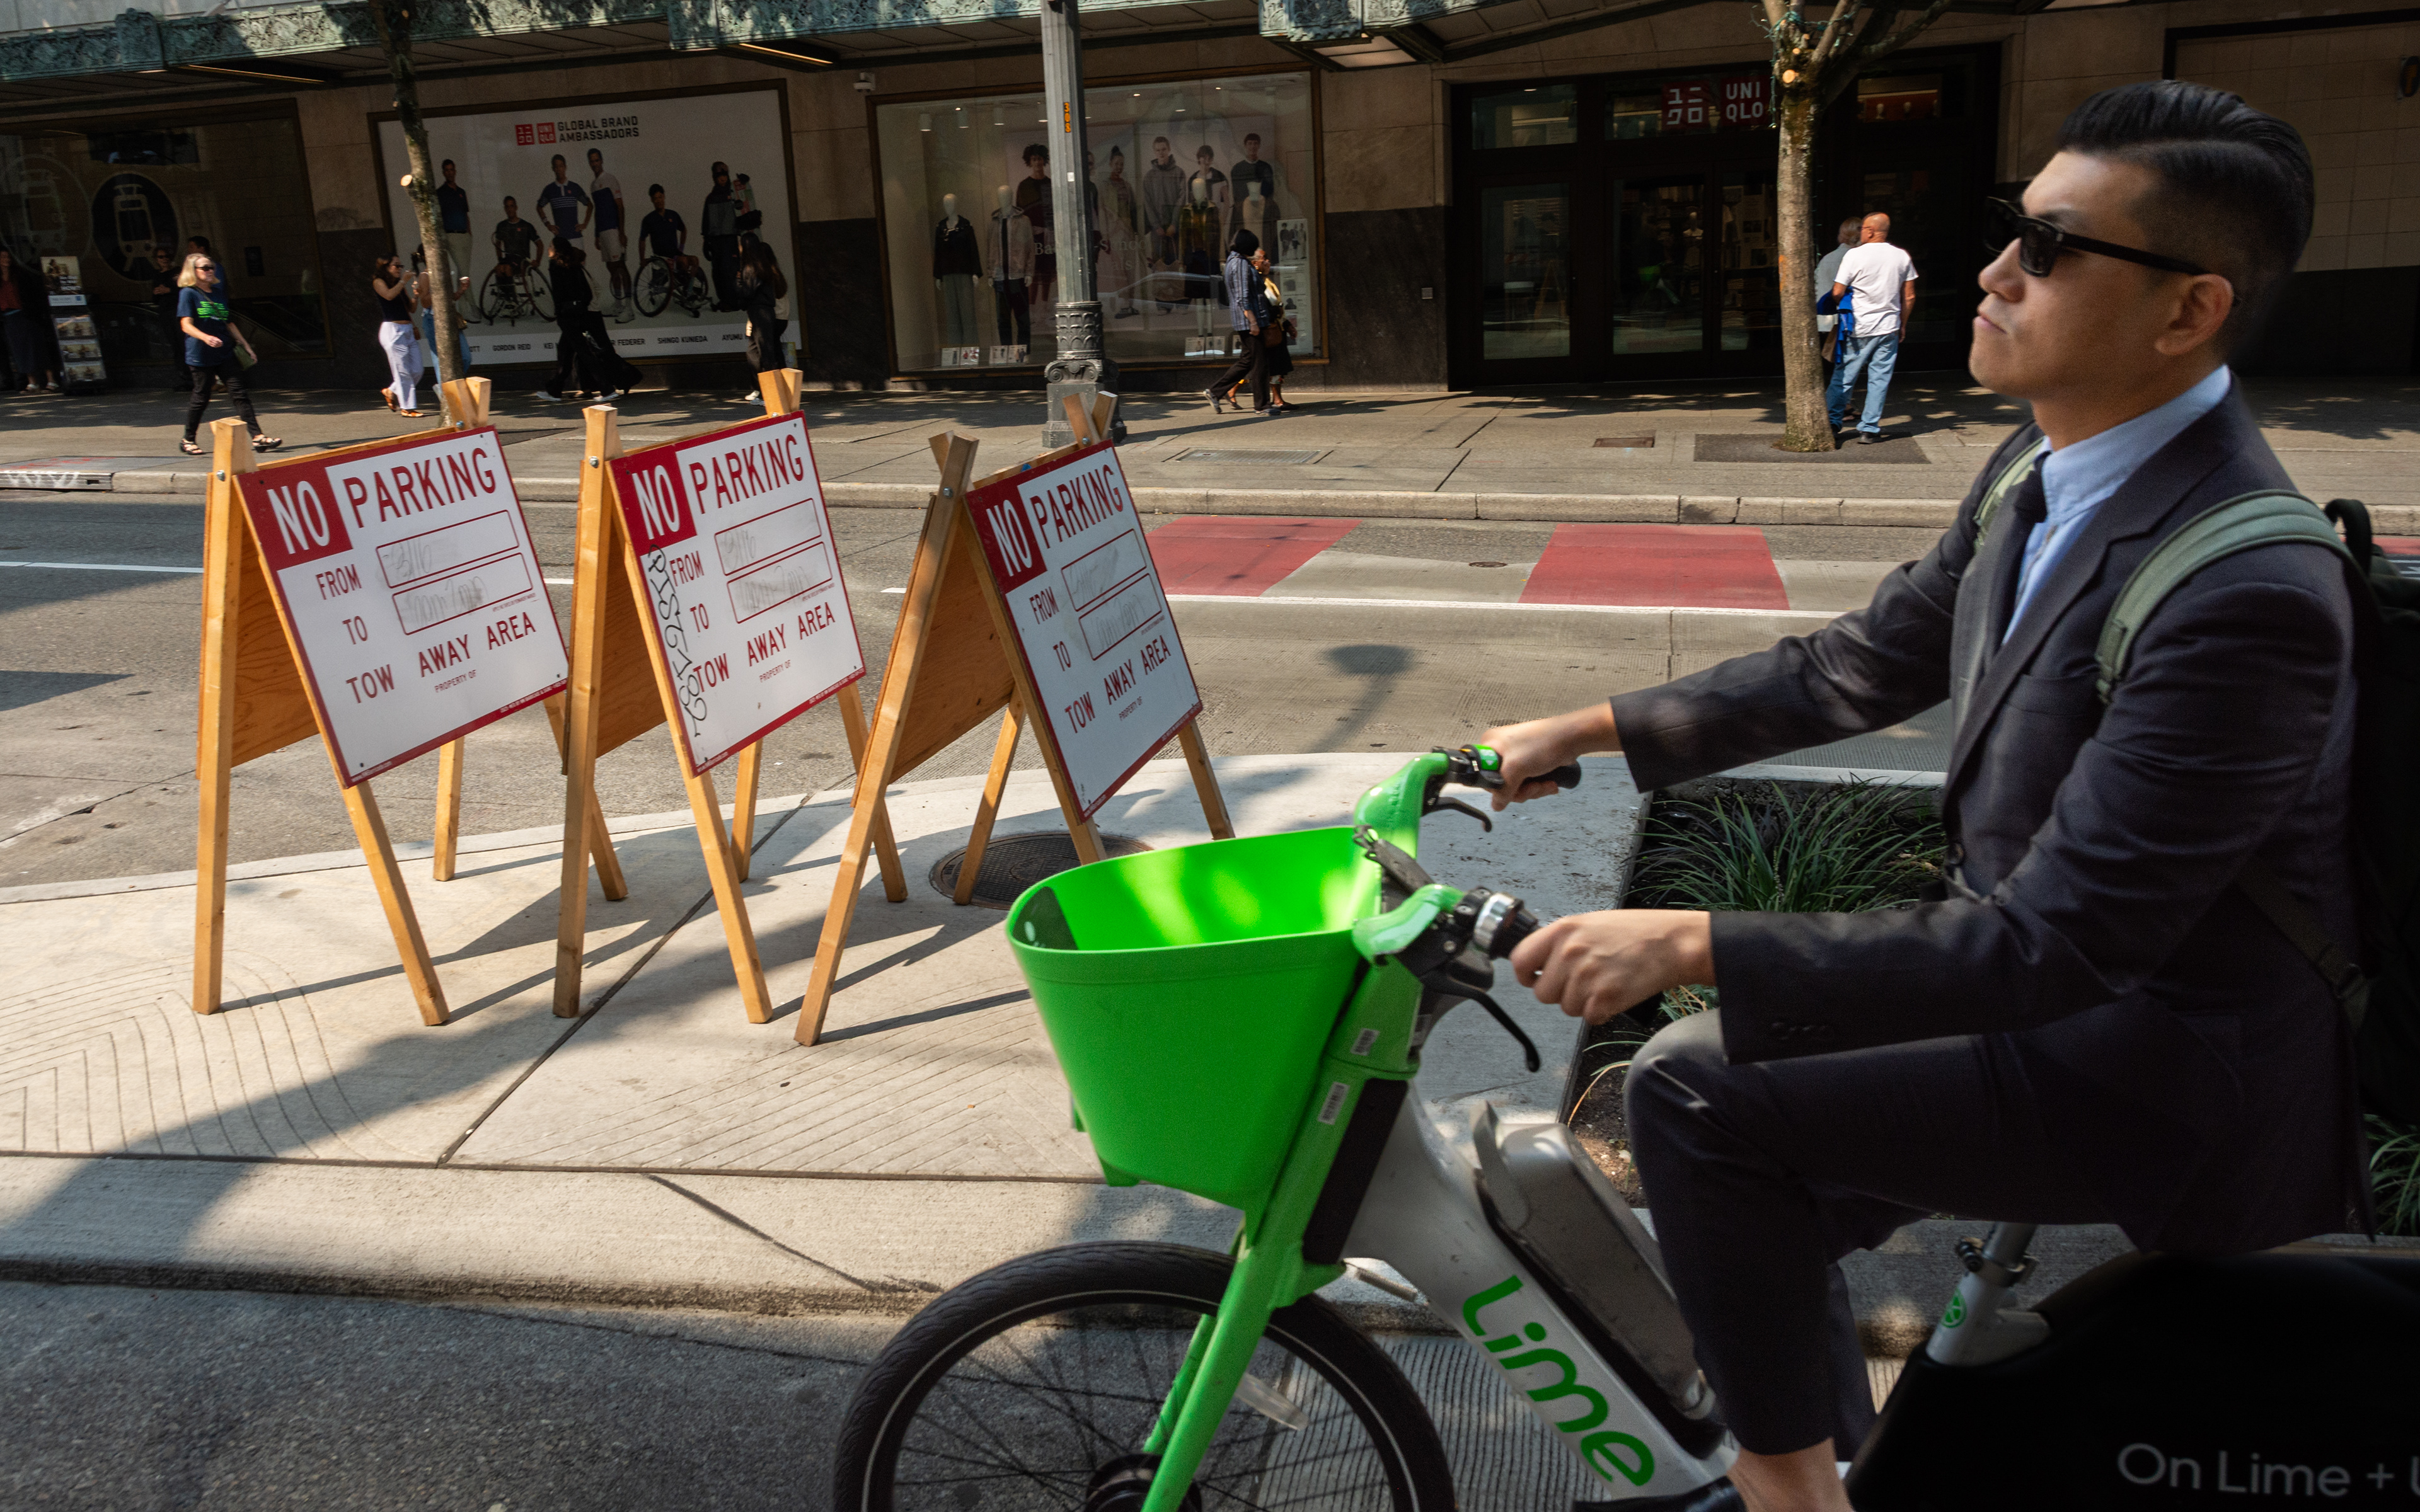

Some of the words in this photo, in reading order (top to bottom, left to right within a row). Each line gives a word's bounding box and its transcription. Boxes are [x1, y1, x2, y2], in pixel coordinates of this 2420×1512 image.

[1668, 87, 1703, 105] ユニ
[1726, 82, 1760, 100] UNI
[557, 119, 598, 131] GLOBAL
[601, 115, 638, 128] BRAND
[1667, 107, 1702, 125] クロ
[1726, 101, 1763, 122] QLO
[538, 124, 553, 133] UNI
[539, 134, 555, 144] QLO
[558, 127, 640, 143] AMBASSADORS
[267, 481, 330, 554] NO
[343, 448, 497, 529] PARKING
[632, 465, 681, 540] NO
[689, 434, 805, 515] PARKING
[986, 500, 1033, 577] NO
[1030, 464, 1124, 549] PARKING
[316, 564, 362, 600] FROM
[669, 551, 705, 587] FROM
[690, 603, 710, 633] TO
[1029, 587, 1059, 624] FROM
[343, 616, 368, 645] TO
[346, 665, 395, 704] TOW
[418, 634, 473, 678] AWAY
[487, 612, 536, 650] AREA
[693, 653, 730, 692] TOW
[747, 624, 787, 667] AWAY
[798, 602, 836, 639] AREA
[1053, 641, 1071, 672] TO
[434, 673, 467, 693] PROPERTY
[468, 670, 476, 679] OF
[759, 664, 784, 683] PROPERTY
[785, 660, 791, 669] OF
[1064, 692, 1096, 733] TOW
[1103, 659, 1136, 705] AWAY
[1140, 635, 1172, 675] AREA
[1461, 1274, 1655, 1487] Lime
[2117, 1442, 2201, 1490] On
[2218, 1450, 2351, 1497] Lime
